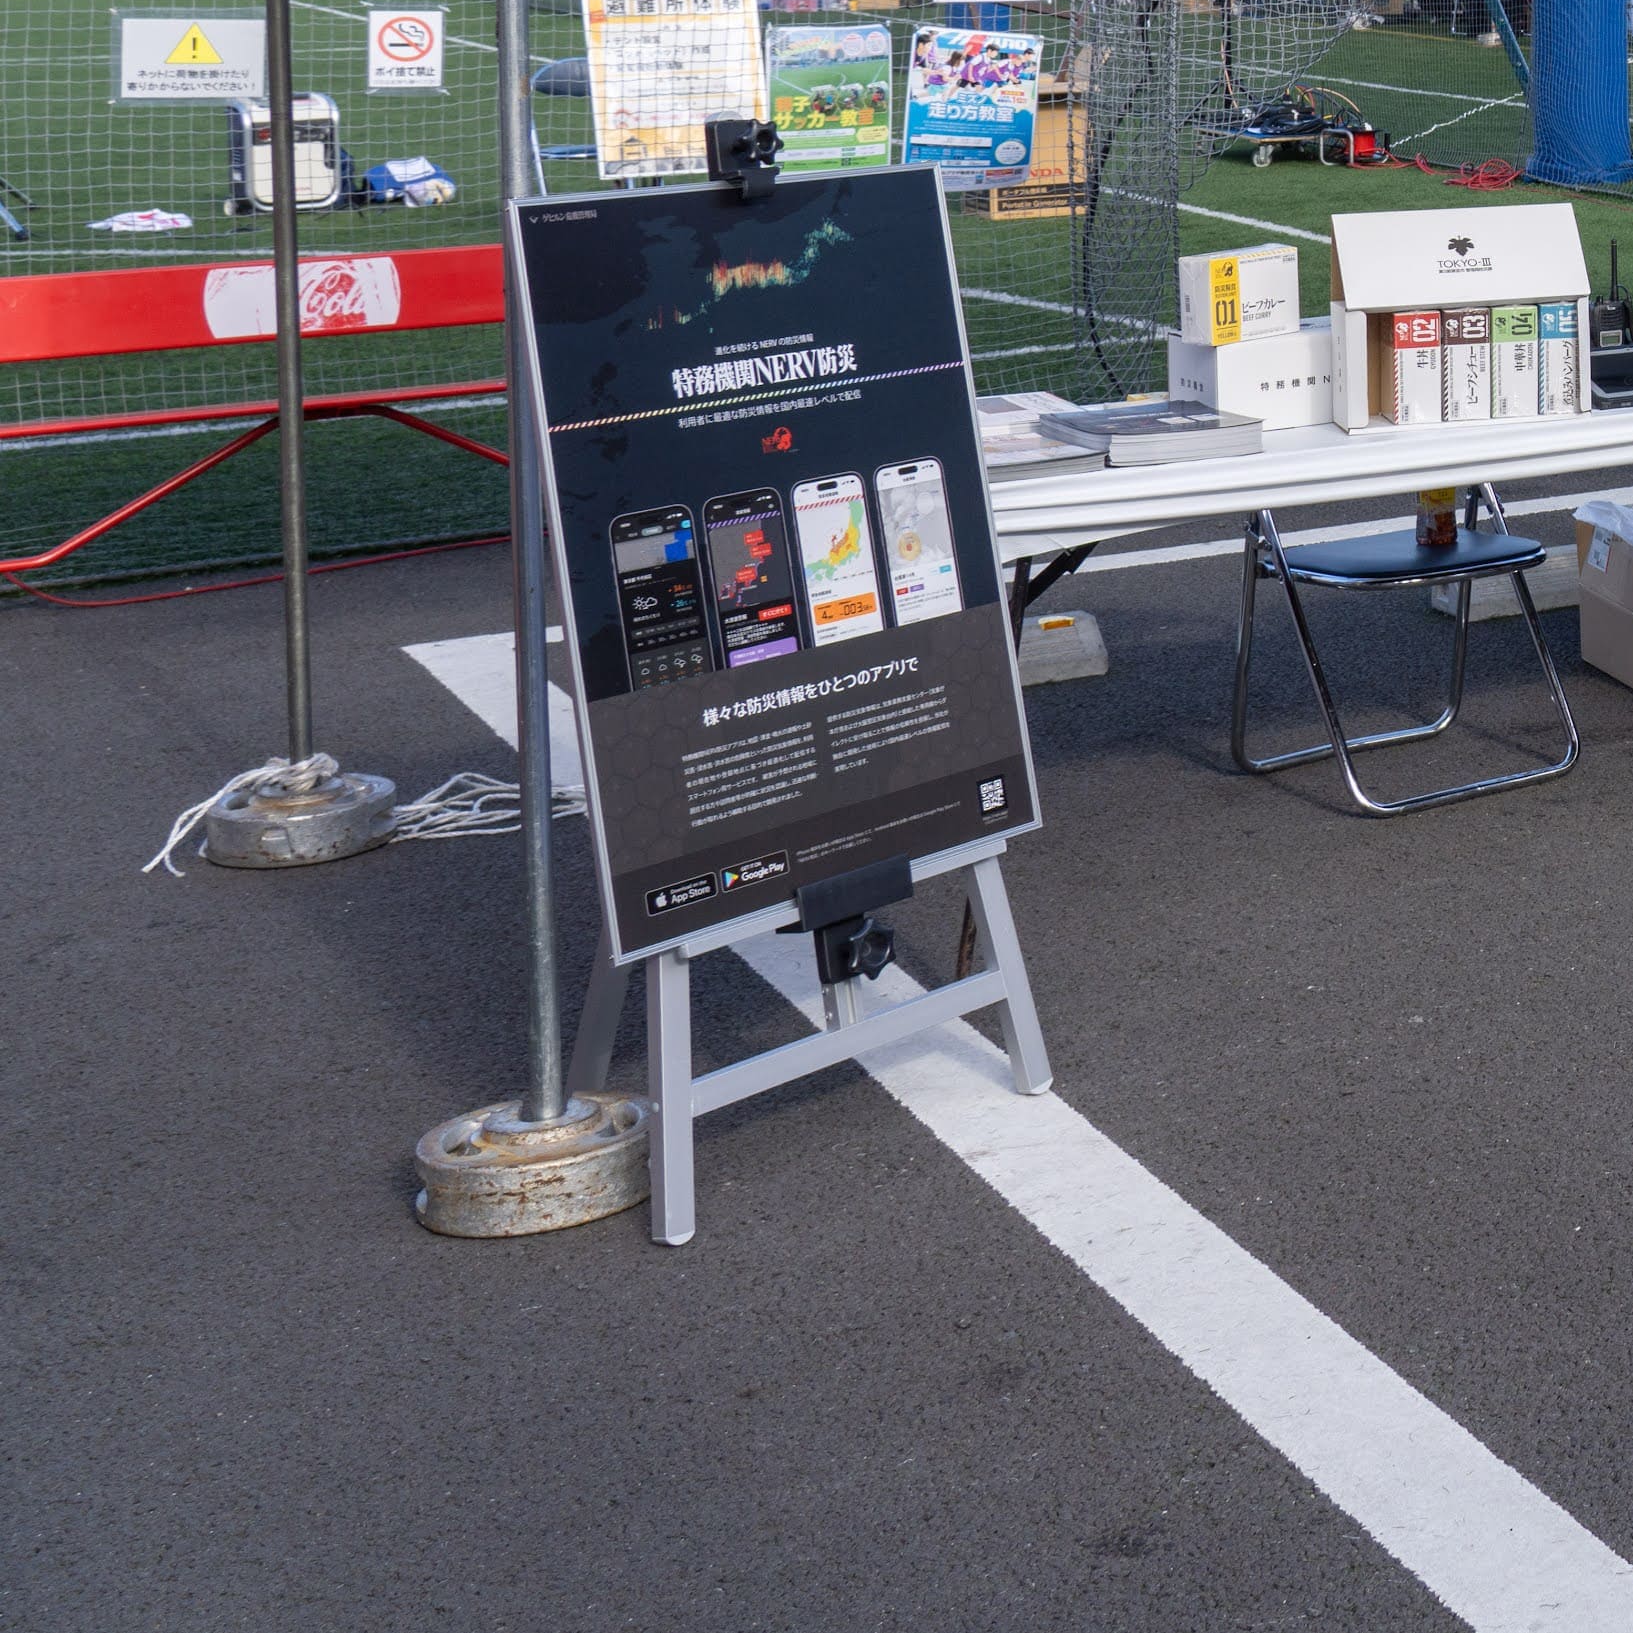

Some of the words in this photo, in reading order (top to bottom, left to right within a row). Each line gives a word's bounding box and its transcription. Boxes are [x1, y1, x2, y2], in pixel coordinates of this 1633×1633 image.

[957, 92, 987, 103] ミズノ
[773, 108, 875, 130] サッカー教室
[927, 102, 1016, 123] 走り方教室
[1030, 168, 1064, 178] NDA
[1215, 298, 1238, 327] 01
[1241, 298, 1286, 314] ビーフカレー
[1412, 317, 1436, 343] 02
[1462, 314, 1486, 339] 03
[1511, 312, 1533, 336] 04
[671, 343, 858, 399] 特務機関NERV防災
[1260, 374, 1331, 391] 特務機関N
[1467, 345, 1480, 405] ビーフシチュー
[702, 656, 920, 727] 様々な防災情報をひとつのアプリで
[740, 866, 768, 883] Google
[768, 860, 786, 876] Play
[671, 889, 689, 906] App
[688, 883, 711, 900] Store
